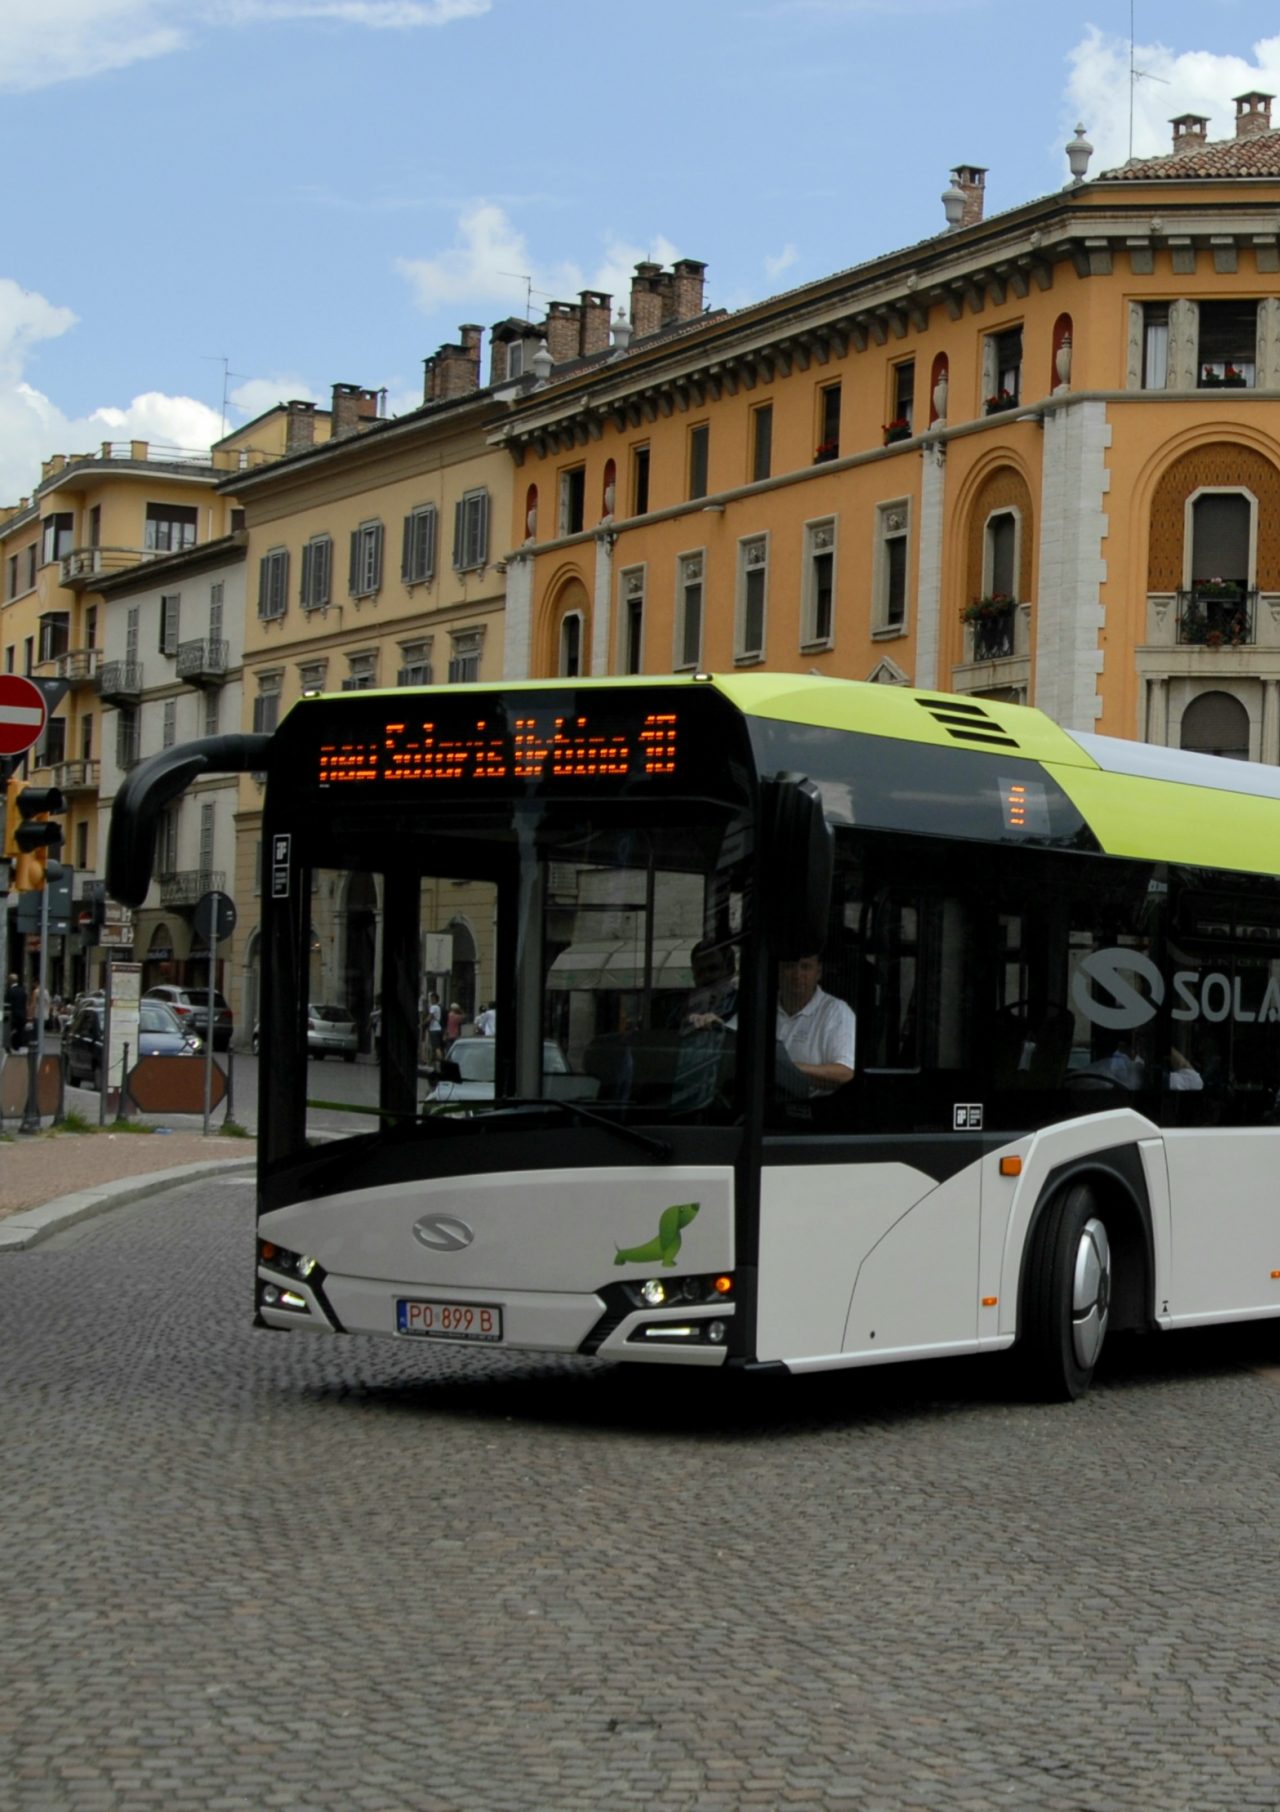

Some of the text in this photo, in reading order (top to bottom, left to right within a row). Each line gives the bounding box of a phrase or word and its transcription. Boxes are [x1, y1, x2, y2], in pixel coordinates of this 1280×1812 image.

[384, 721, 505, 779] Solaris
[514, 717, 628, 776] Urbino
[638, 714, 677, 773] 18
[441, 1306, 474, 1331] 899
[480, 1309, 493, 1332] B
